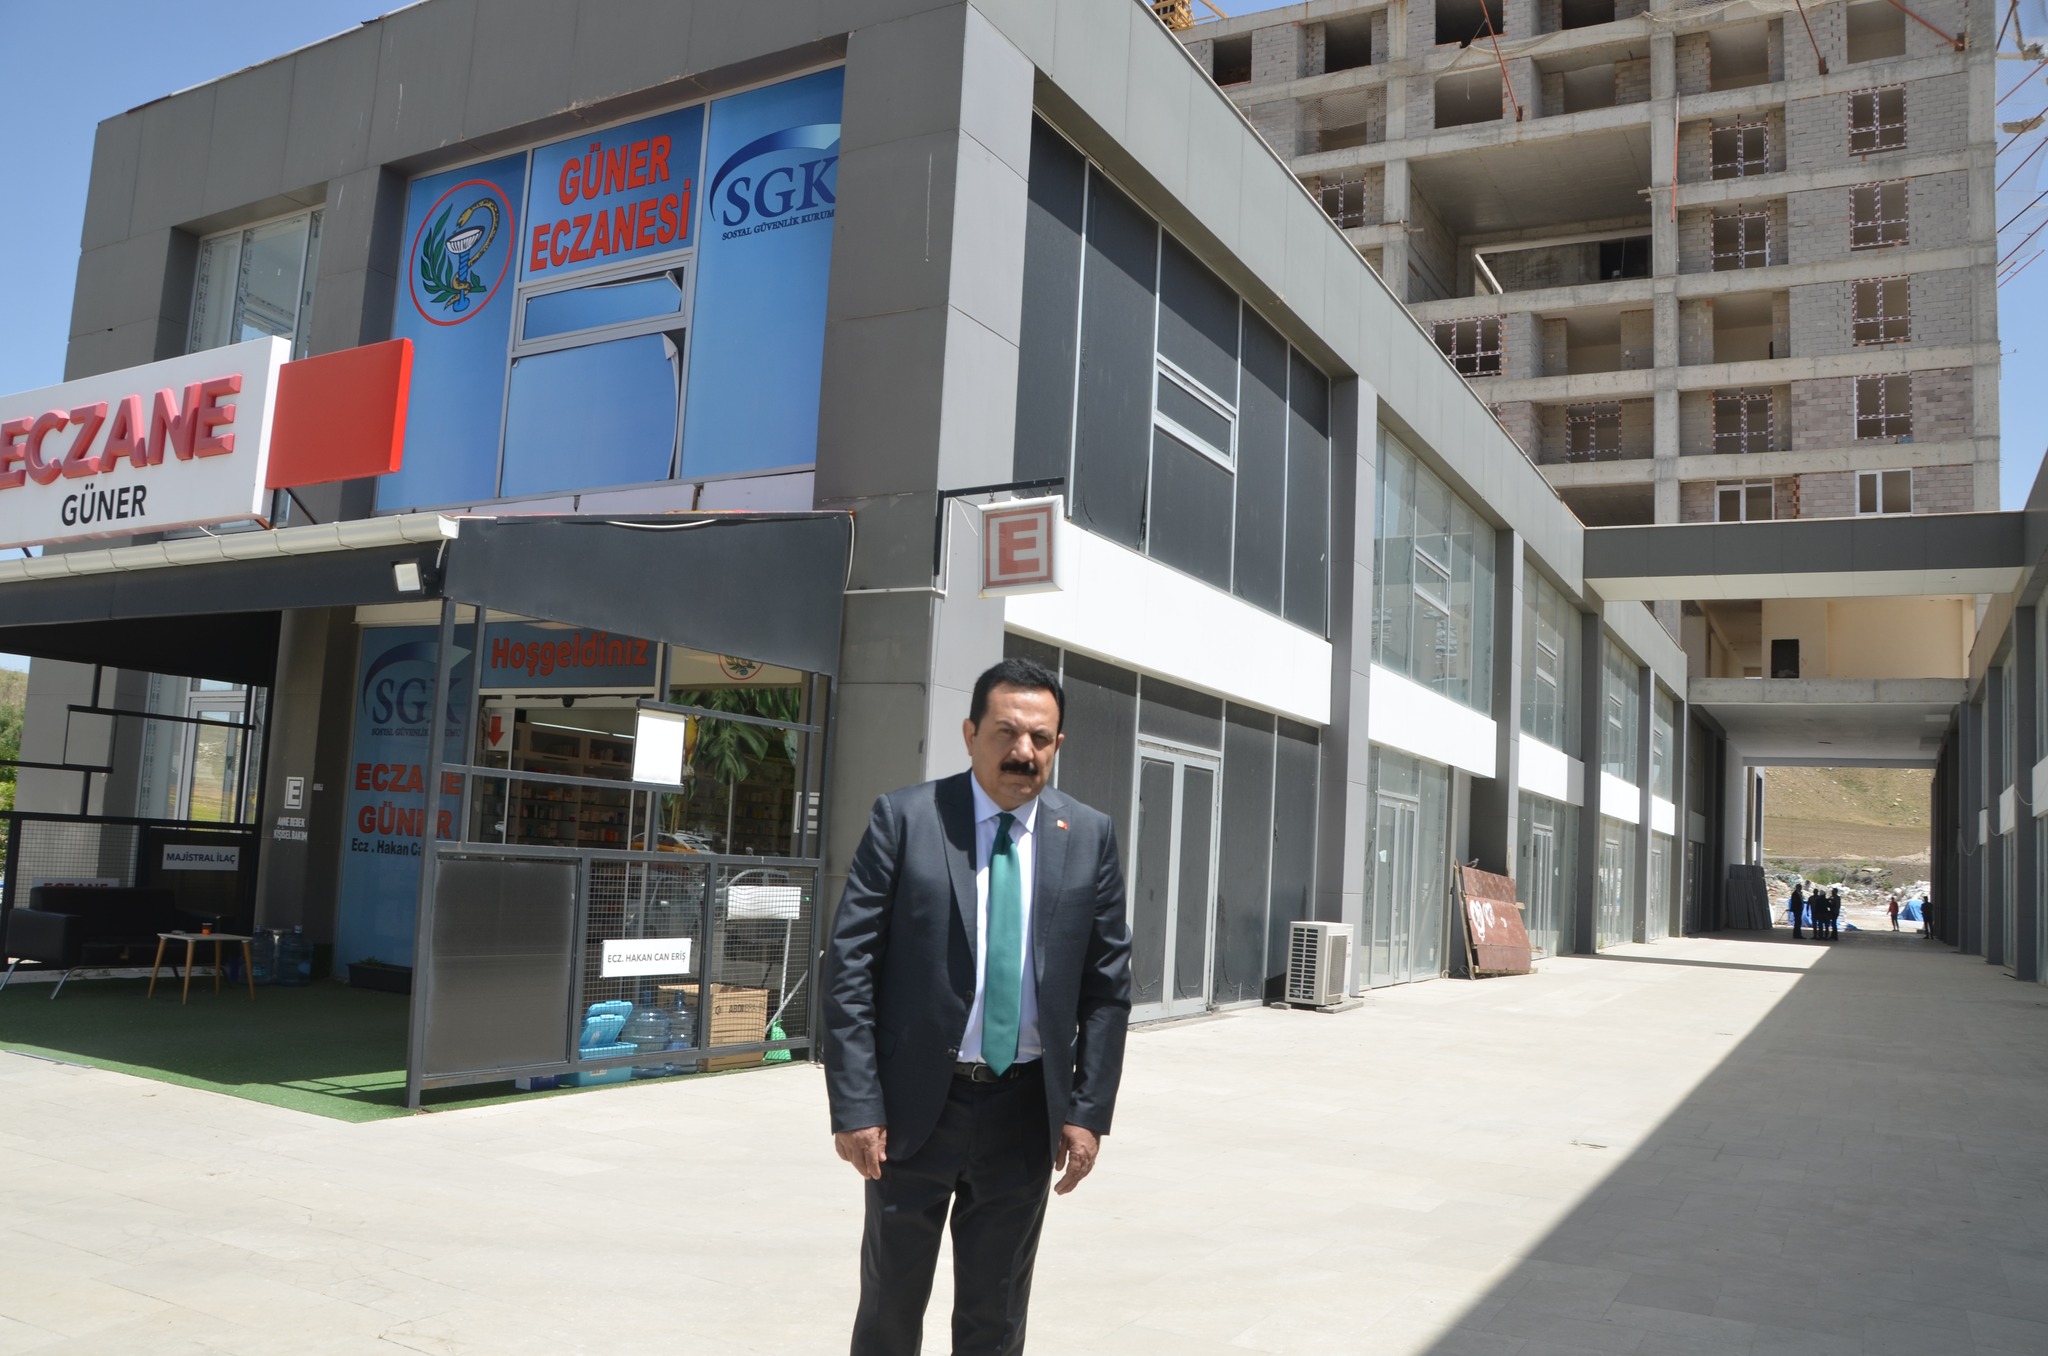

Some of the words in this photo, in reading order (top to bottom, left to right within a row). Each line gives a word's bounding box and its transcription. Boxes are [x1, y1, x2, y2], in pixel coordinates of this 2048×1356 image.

[559, 134, 672, 206] GÜNER
[723, 155, 839, 226] SGK
[529, 178, 691, 272] ECZANESİ
[721, 227, 752, 241] SOSYAL
[753, 216, 800, 235] GÜVENLİK
[0, 373, 243, 490] ECZANE
[61, 482, 147, 527] GÜNER
[998, 517, 1040, 576] E
[491, 630, 649, 677] Hoşgeldiniz
[355, 763, 464, 795] ECZAE
[166, 851, 215, 863] MAJİSTRAL
[216, 852, 236, 865] İLAÇ
[376, 839, 409, 857] Hakan
[607, 954, 624, 963] ECZ.
[625, 953, 653, 963] HAKAN
[654, 952, 670, 961] CAN
[671, 950, 687, 963] ERİŞ
